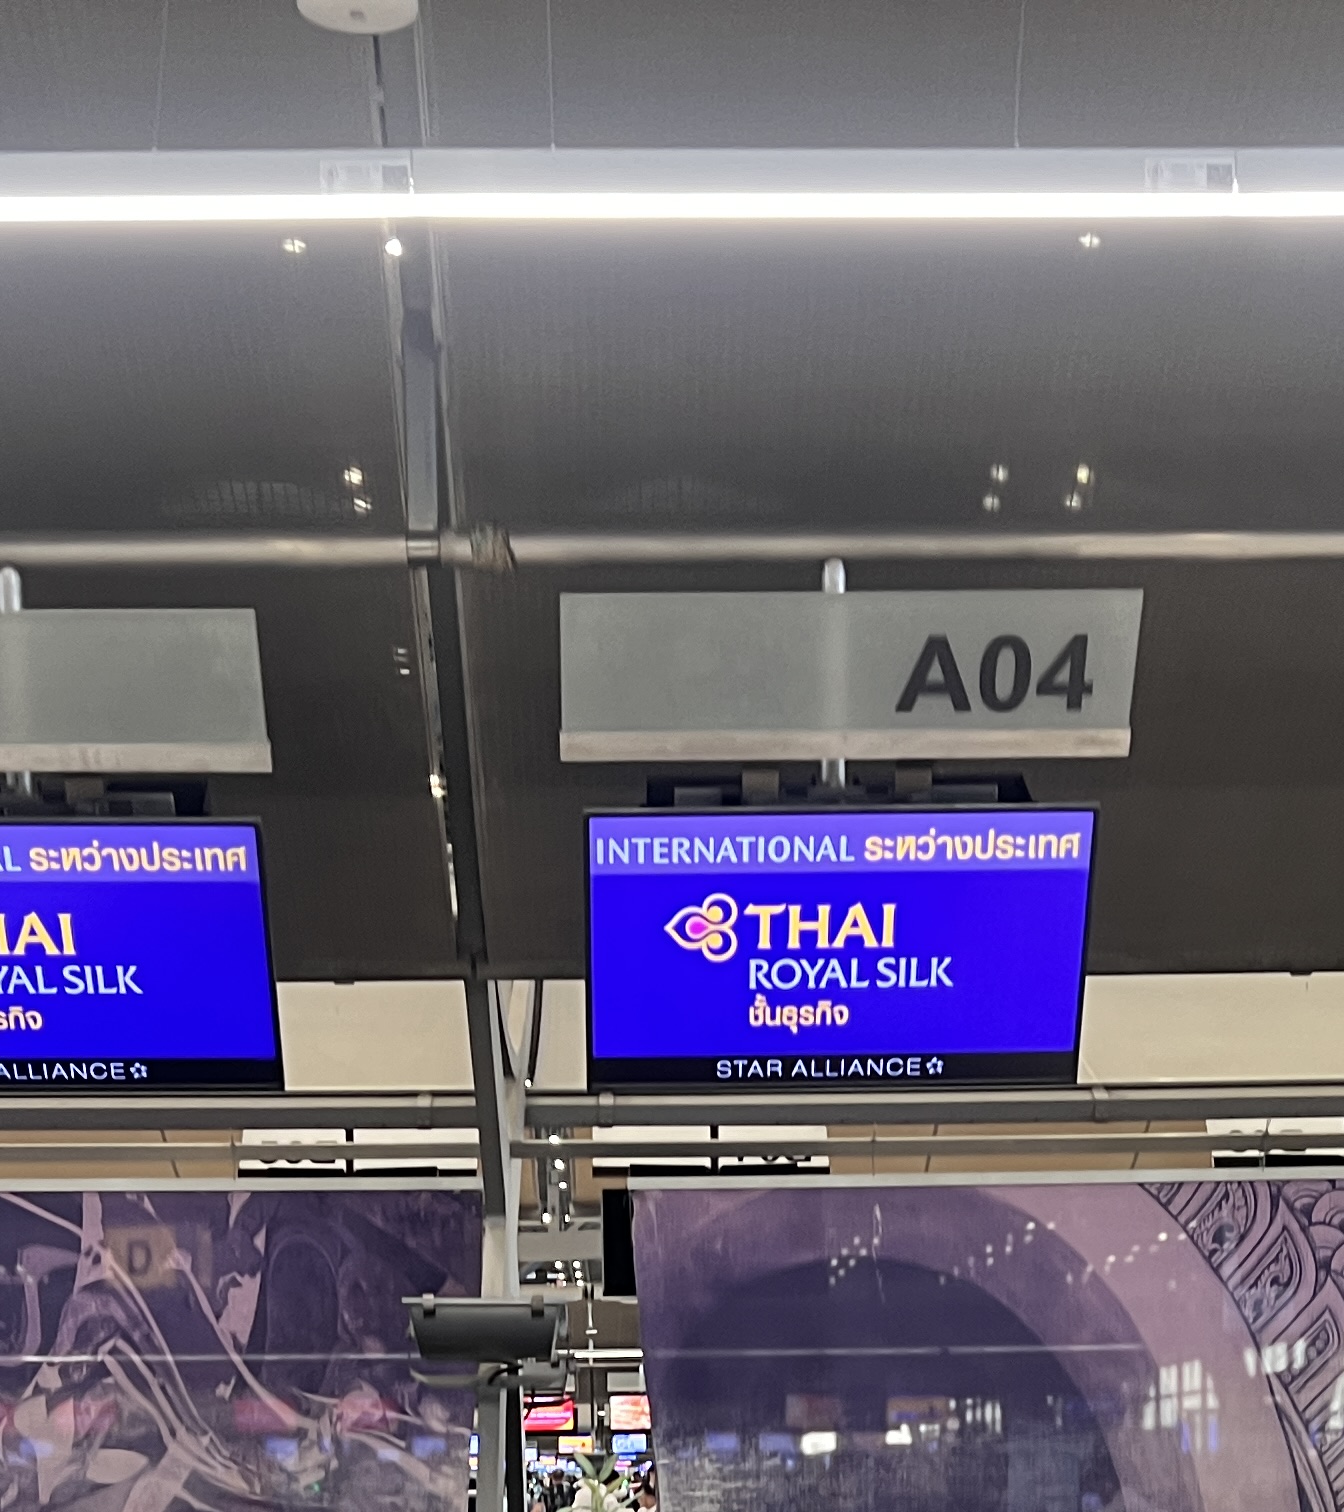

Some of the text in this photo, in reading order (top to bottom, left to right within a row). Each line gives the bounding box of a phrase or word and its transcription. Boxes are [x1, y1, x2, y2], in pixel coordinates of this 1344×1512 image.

[895, 633, 1094, 713] A04
[29, 840, 247, 873] ระหว่างประเทศ
[596, 828, 1081, 865] INTERNATIONAL ระหว่างประเทศ
[744, 902, 897, 950] THAI
[62, 964, 144, 995] SILK
[749, 956, 954, 990] ROYAL SILK
[749, 993, 850, 1034] ชั้นธุรกิจ
[716, 1057, 922, 1078] STAR ALLIANCE
